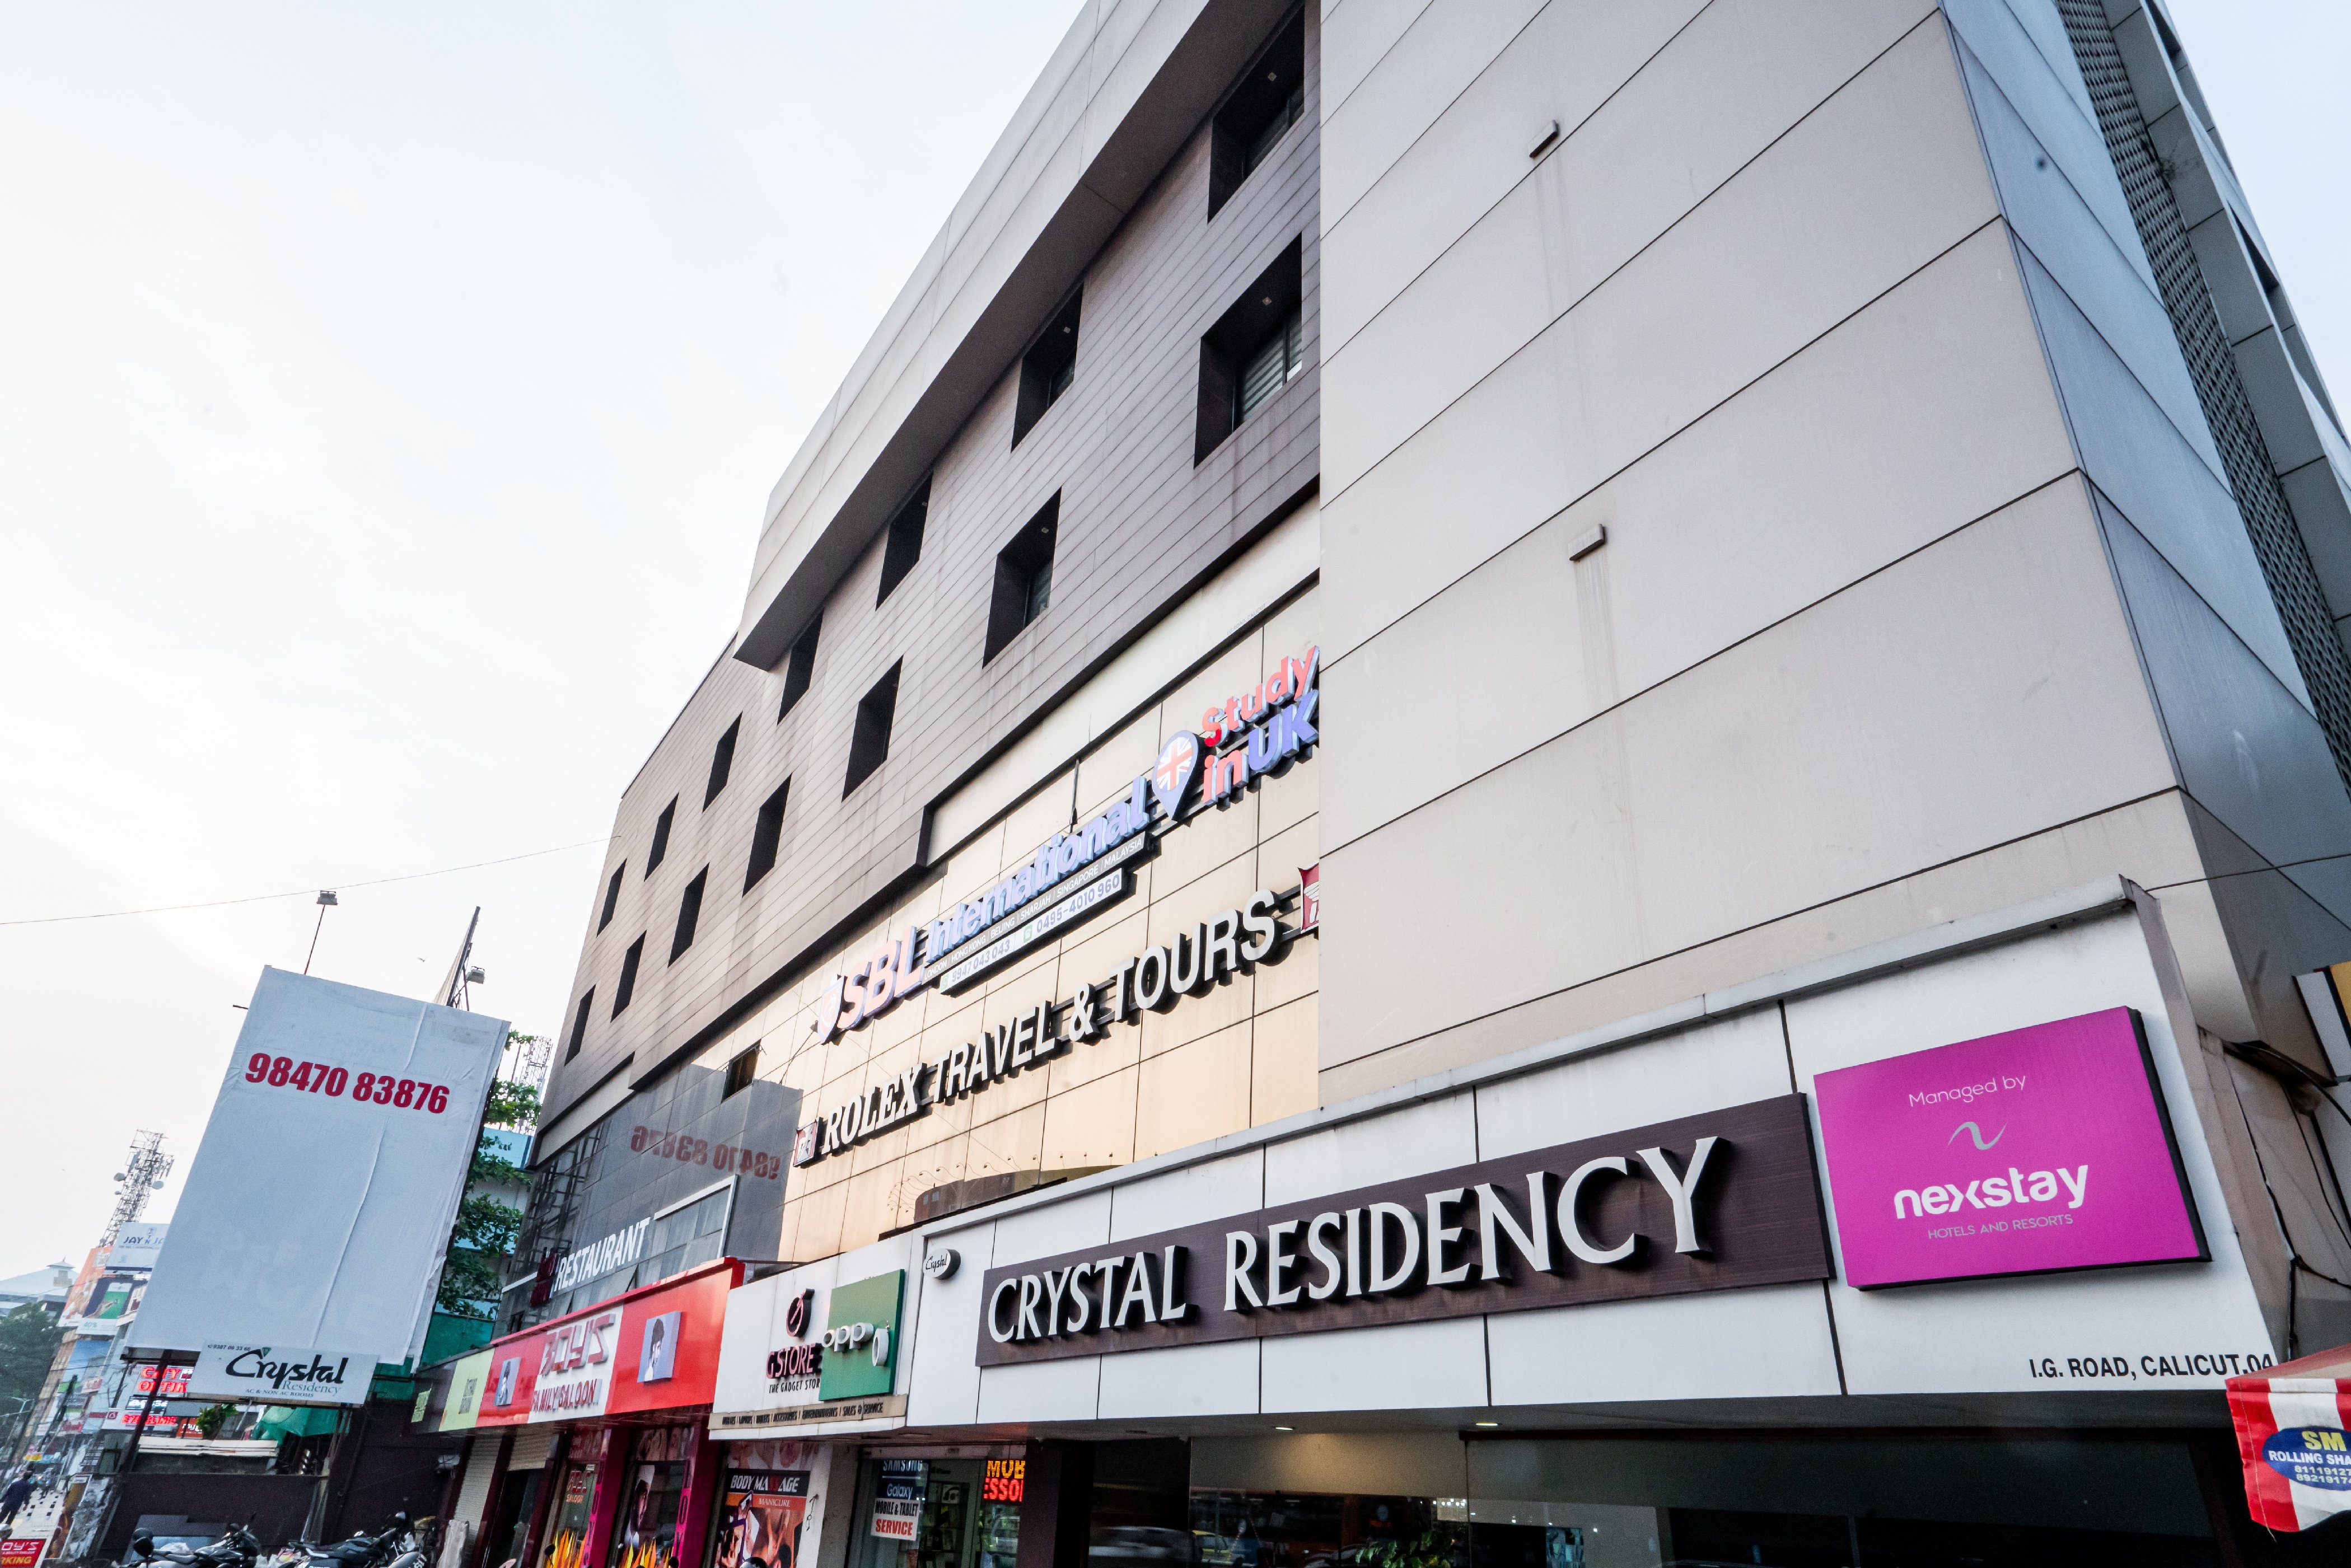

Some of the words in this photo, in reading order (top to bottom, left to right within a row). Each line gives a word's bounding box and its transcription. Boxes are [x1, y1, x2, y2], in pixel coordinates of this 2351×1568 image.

[1202, 645, 1319, 746] Study
[1204, 750, 1247, 804] in
[1248, 690, 1318, 771] UK
[838, 925, 923, 1028] SBL
[926, 776, 1148, 963] International
[924, 959, 947, 980] LONDON
[951, 947, 968, 962] HONG
[969, 937, 986, 953] KONG
[990, 918, 1015, 938] BEIJING
[1020, 895, 1051, 920] SHARJAH
[1057, 864, 1099, 897] SINGAPORE
[1104, 838, 1142, 868] MALAYSIA
[952, 960, 972, 982] 9947
[973, 952, 990, 971] 043
[992, 939, 1010, 960] 043
[1036, 888, 1095, 933] 0495-4010
[1097, 874, 1120, 897] 960
[821, 1063, 925, 1155] ROLEX
[933, 1000, 1055, 1103] TRAVEL
[1068, 982, 1094, 1042] &
[1110, 889, 1275, 1023] TOURS
[245, 1052, 349, 1097] 98470
[352, 1072, 450, 1114] 83876
[1908, 1078, 1997, 1107] Managed
[2003, 1075, 2026, 1091] by
[1894, 1164, 2088, 1220] nexstay
[1928, 1224, 1975, 1239] HOTELS
[1980, 1221, 2008, 1234] AND
[2013, 1213, 2073, 1230] RESORTS
[987, 1243, 1190, 1344] CRYSTAL
[1224, 1135, 1719, 1312] RESIDENCY
[554, 1216, 651, 1292] RESTAURANT
[926, 1253, 948, 1272] Crystal
[225, 1349, 349, 1389] Crystal
[2029, 1358, 2063, 1378] I.G.
[2067, 1356, 2137, 1381] ROAD,
[282, 1380, 341, 1397] Residency
[559, 1379, 597, 1407] SALOON
[769, 1384, 779, 1394] THE
[780, 1380, 803, 1393] GADGET
[805, 1378, 820, 1391] STOR
[843, 1405, 857, 1416] SALES
[2301, 1431, 2347, 1452] SM
[883, 1460, 923, 1472] SAMSUNG
[2268, 1450, 2323, 1464] ROLLING
[730, 1475, 755, 1490] BODY
[886, 1483, 913, 1500] Galaxy
[758, 1497, 791, 1507] MANICURE
[875, 1500, 894, 1514] MOBILE
[894, 1506, 899, 1516] &
[899, 1502, 919, 1517] TABLET
[876, 1518, 913, 1537] SERVICE
[1, 1542, 39, 1551] OY'S
